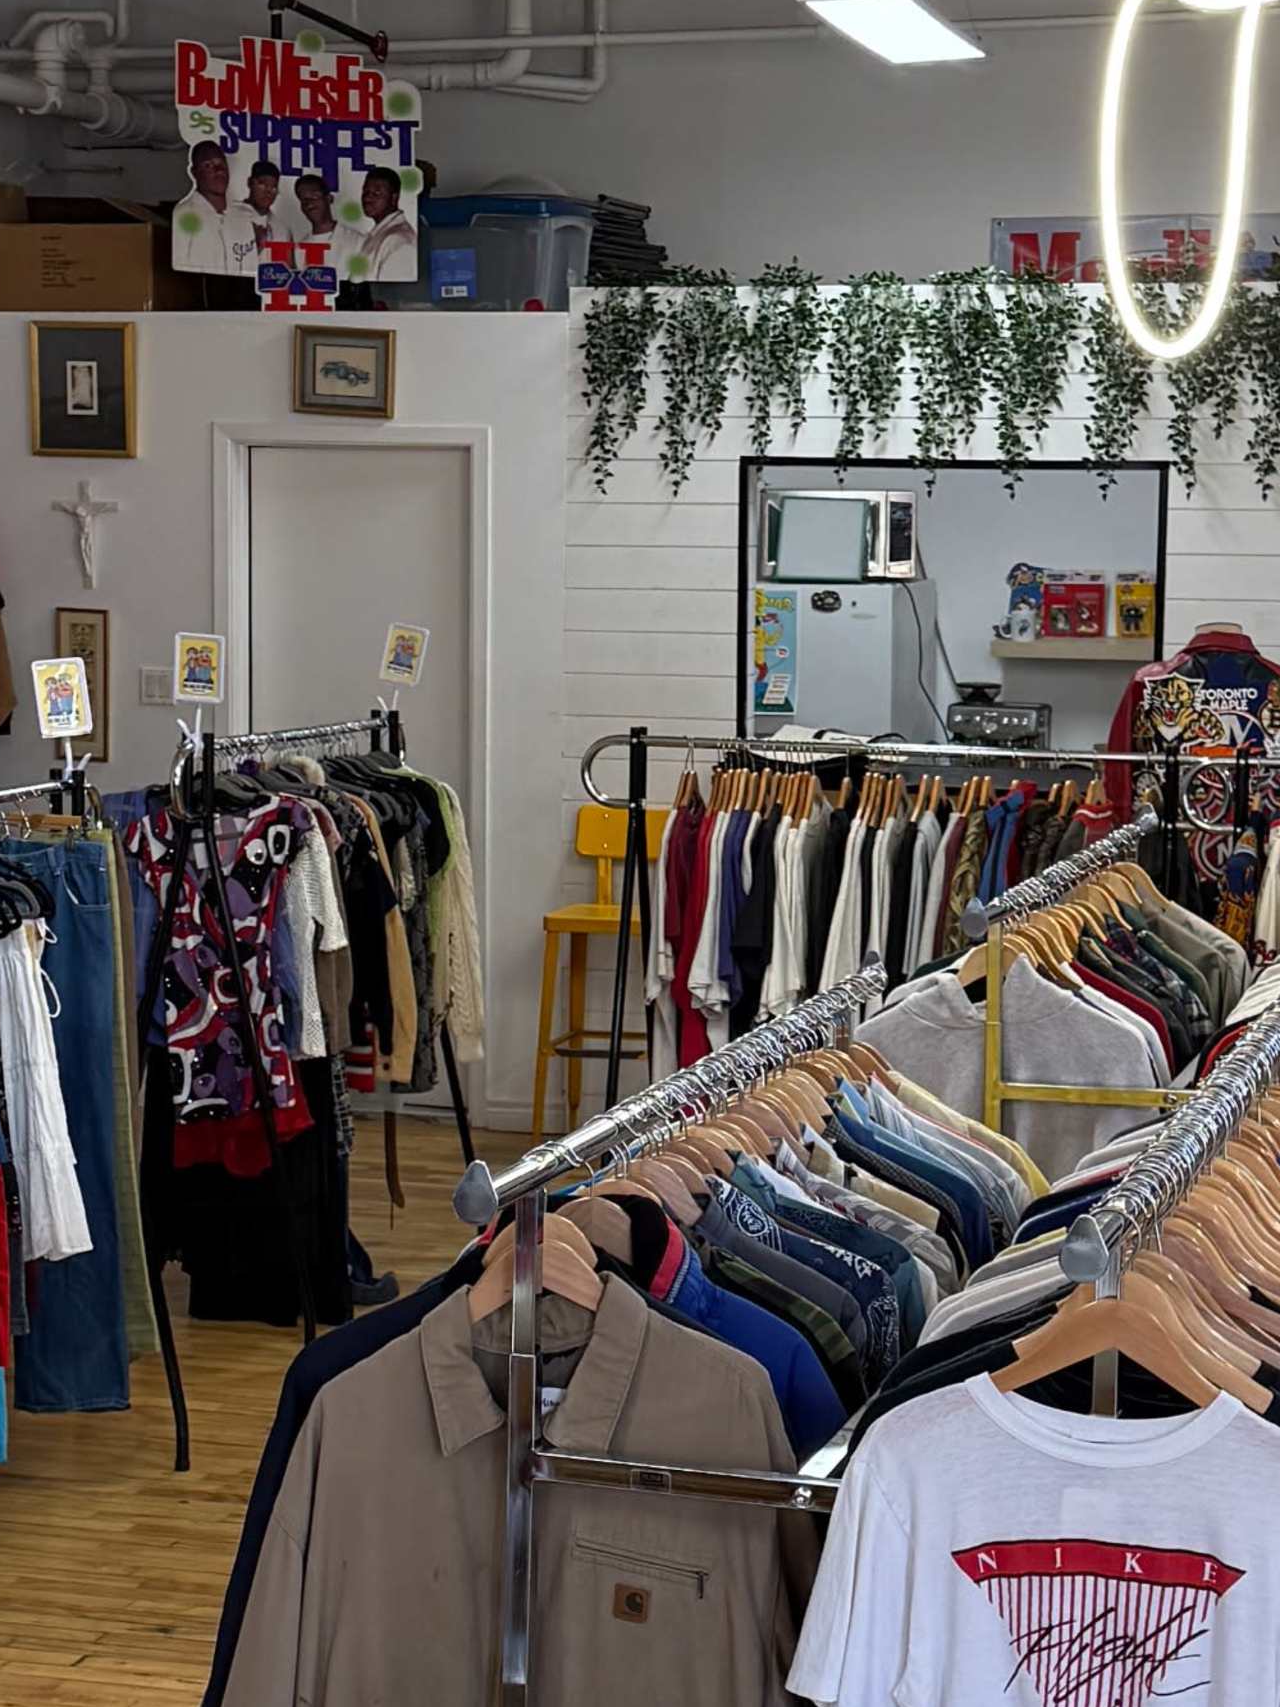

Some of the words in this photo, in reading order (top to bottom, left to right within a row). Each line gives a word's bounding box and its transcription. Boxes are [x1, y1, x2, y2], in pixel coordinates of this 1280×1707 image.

[1200, 688, 1258, 700] TORONTO
[1210, 700, 1250, 711] MAPLE
[977, 1547, 1218, 1584] NIKE
